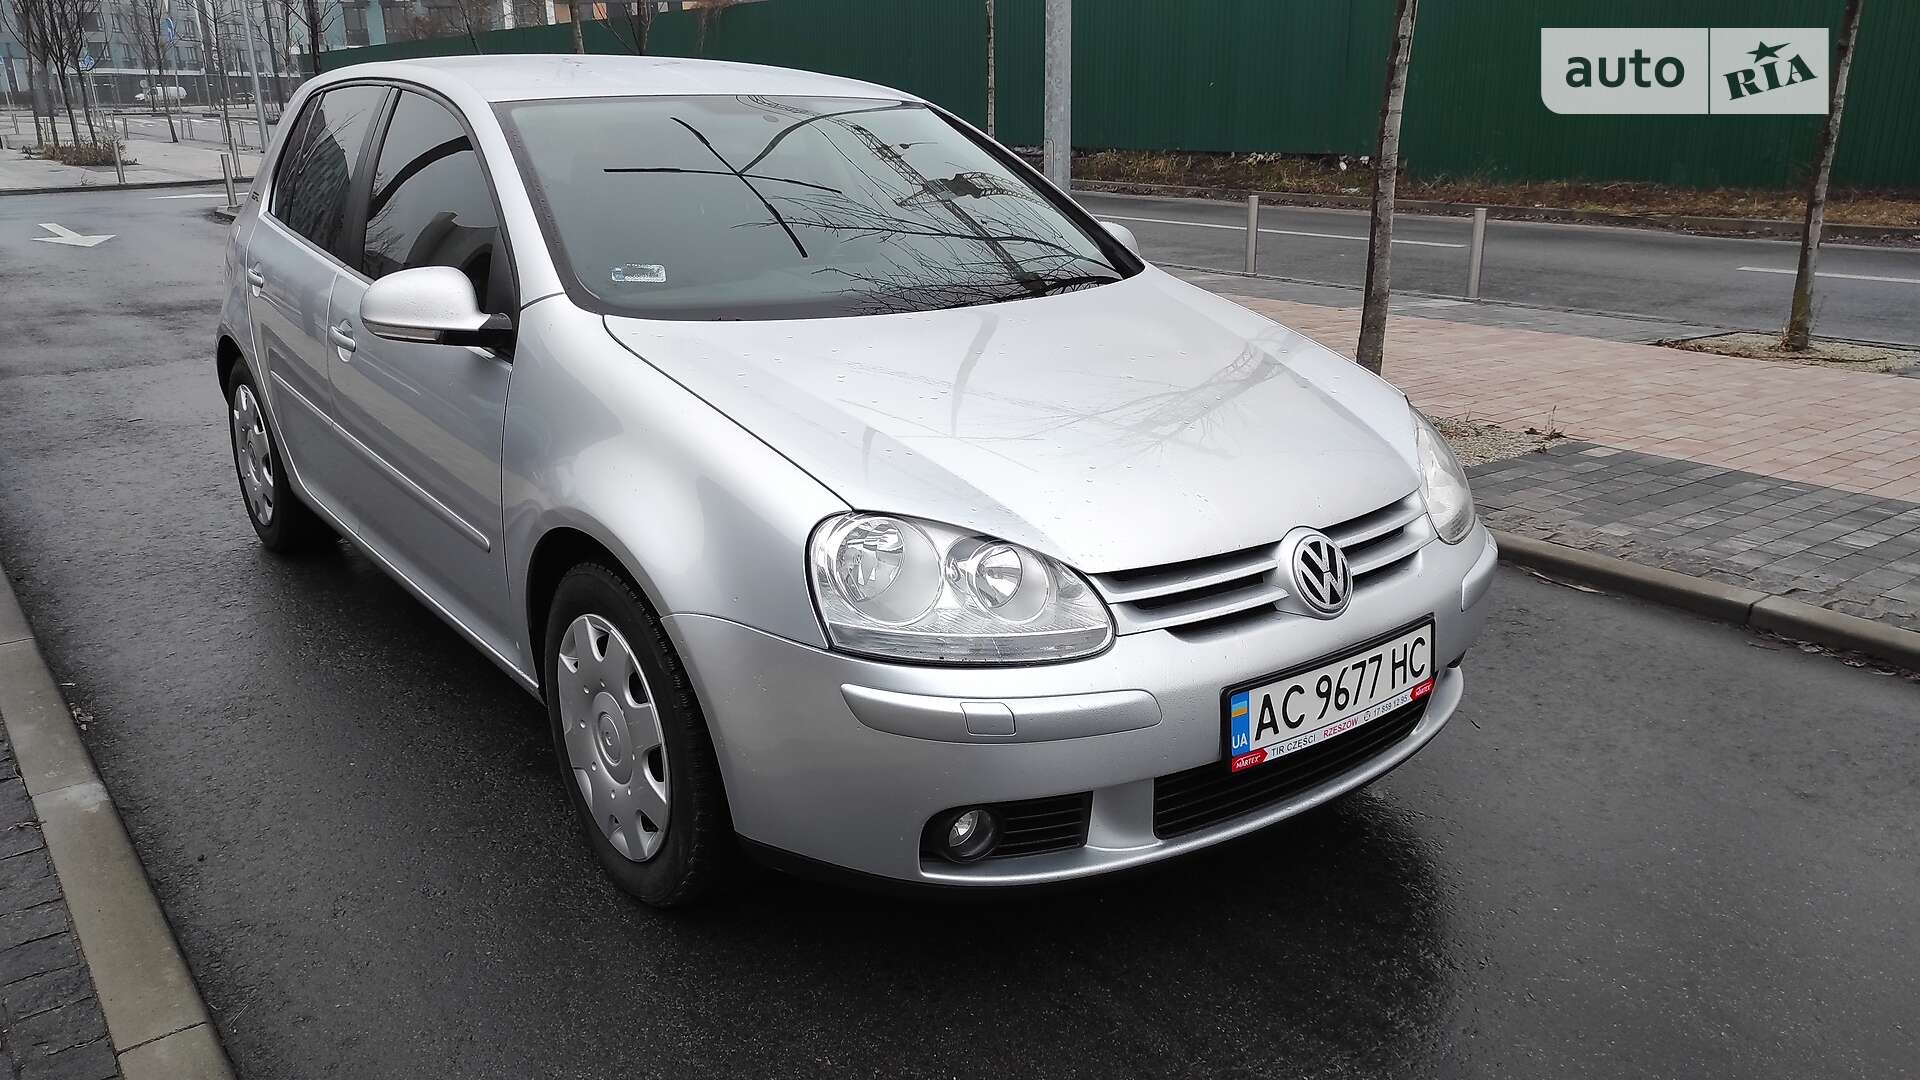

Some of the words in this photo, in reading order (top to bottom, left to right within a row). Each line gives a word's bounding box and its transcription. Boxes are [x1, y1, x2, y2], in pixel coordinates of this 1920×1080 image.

[1254, 685, 1306, 741] AC
[1315, 653, 1383, 720] 9677
[1391, 637, 1426, 690] HC
[1232, 732, 1248, 749] UA
[1271, 745, 1285, 757] TIR
